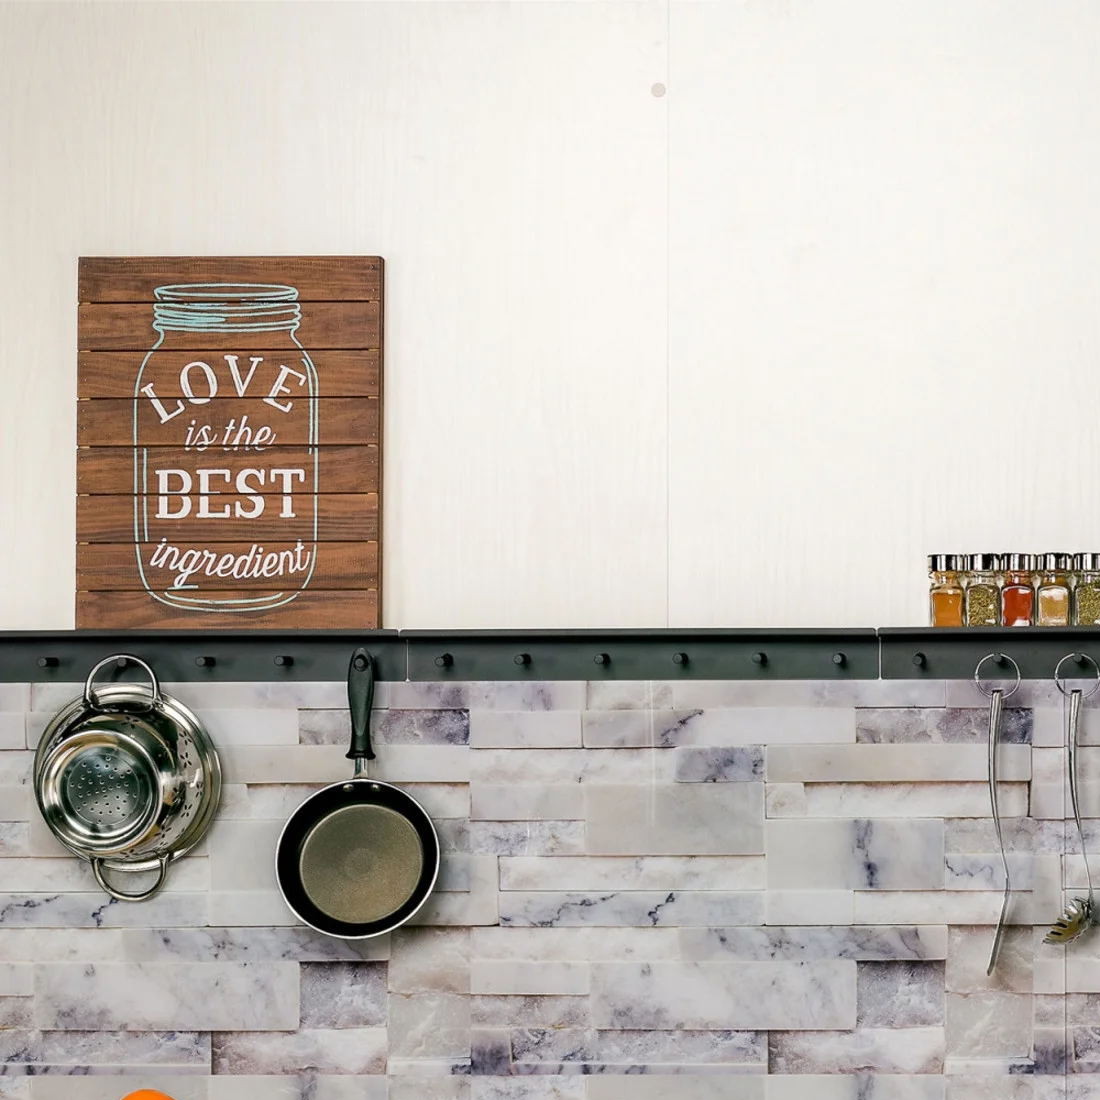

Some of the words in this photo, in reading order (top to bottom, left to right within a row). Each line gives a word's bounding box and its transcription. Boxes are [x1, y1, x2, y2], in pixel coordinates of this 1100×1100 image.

[140, 354, 307, 424] LOVE
[184, 419, 217, 452] is
[223, 415, 277, 452] the
[154, 468, 305, 519] BEST
[149, 537, 311, 588] ingredient
